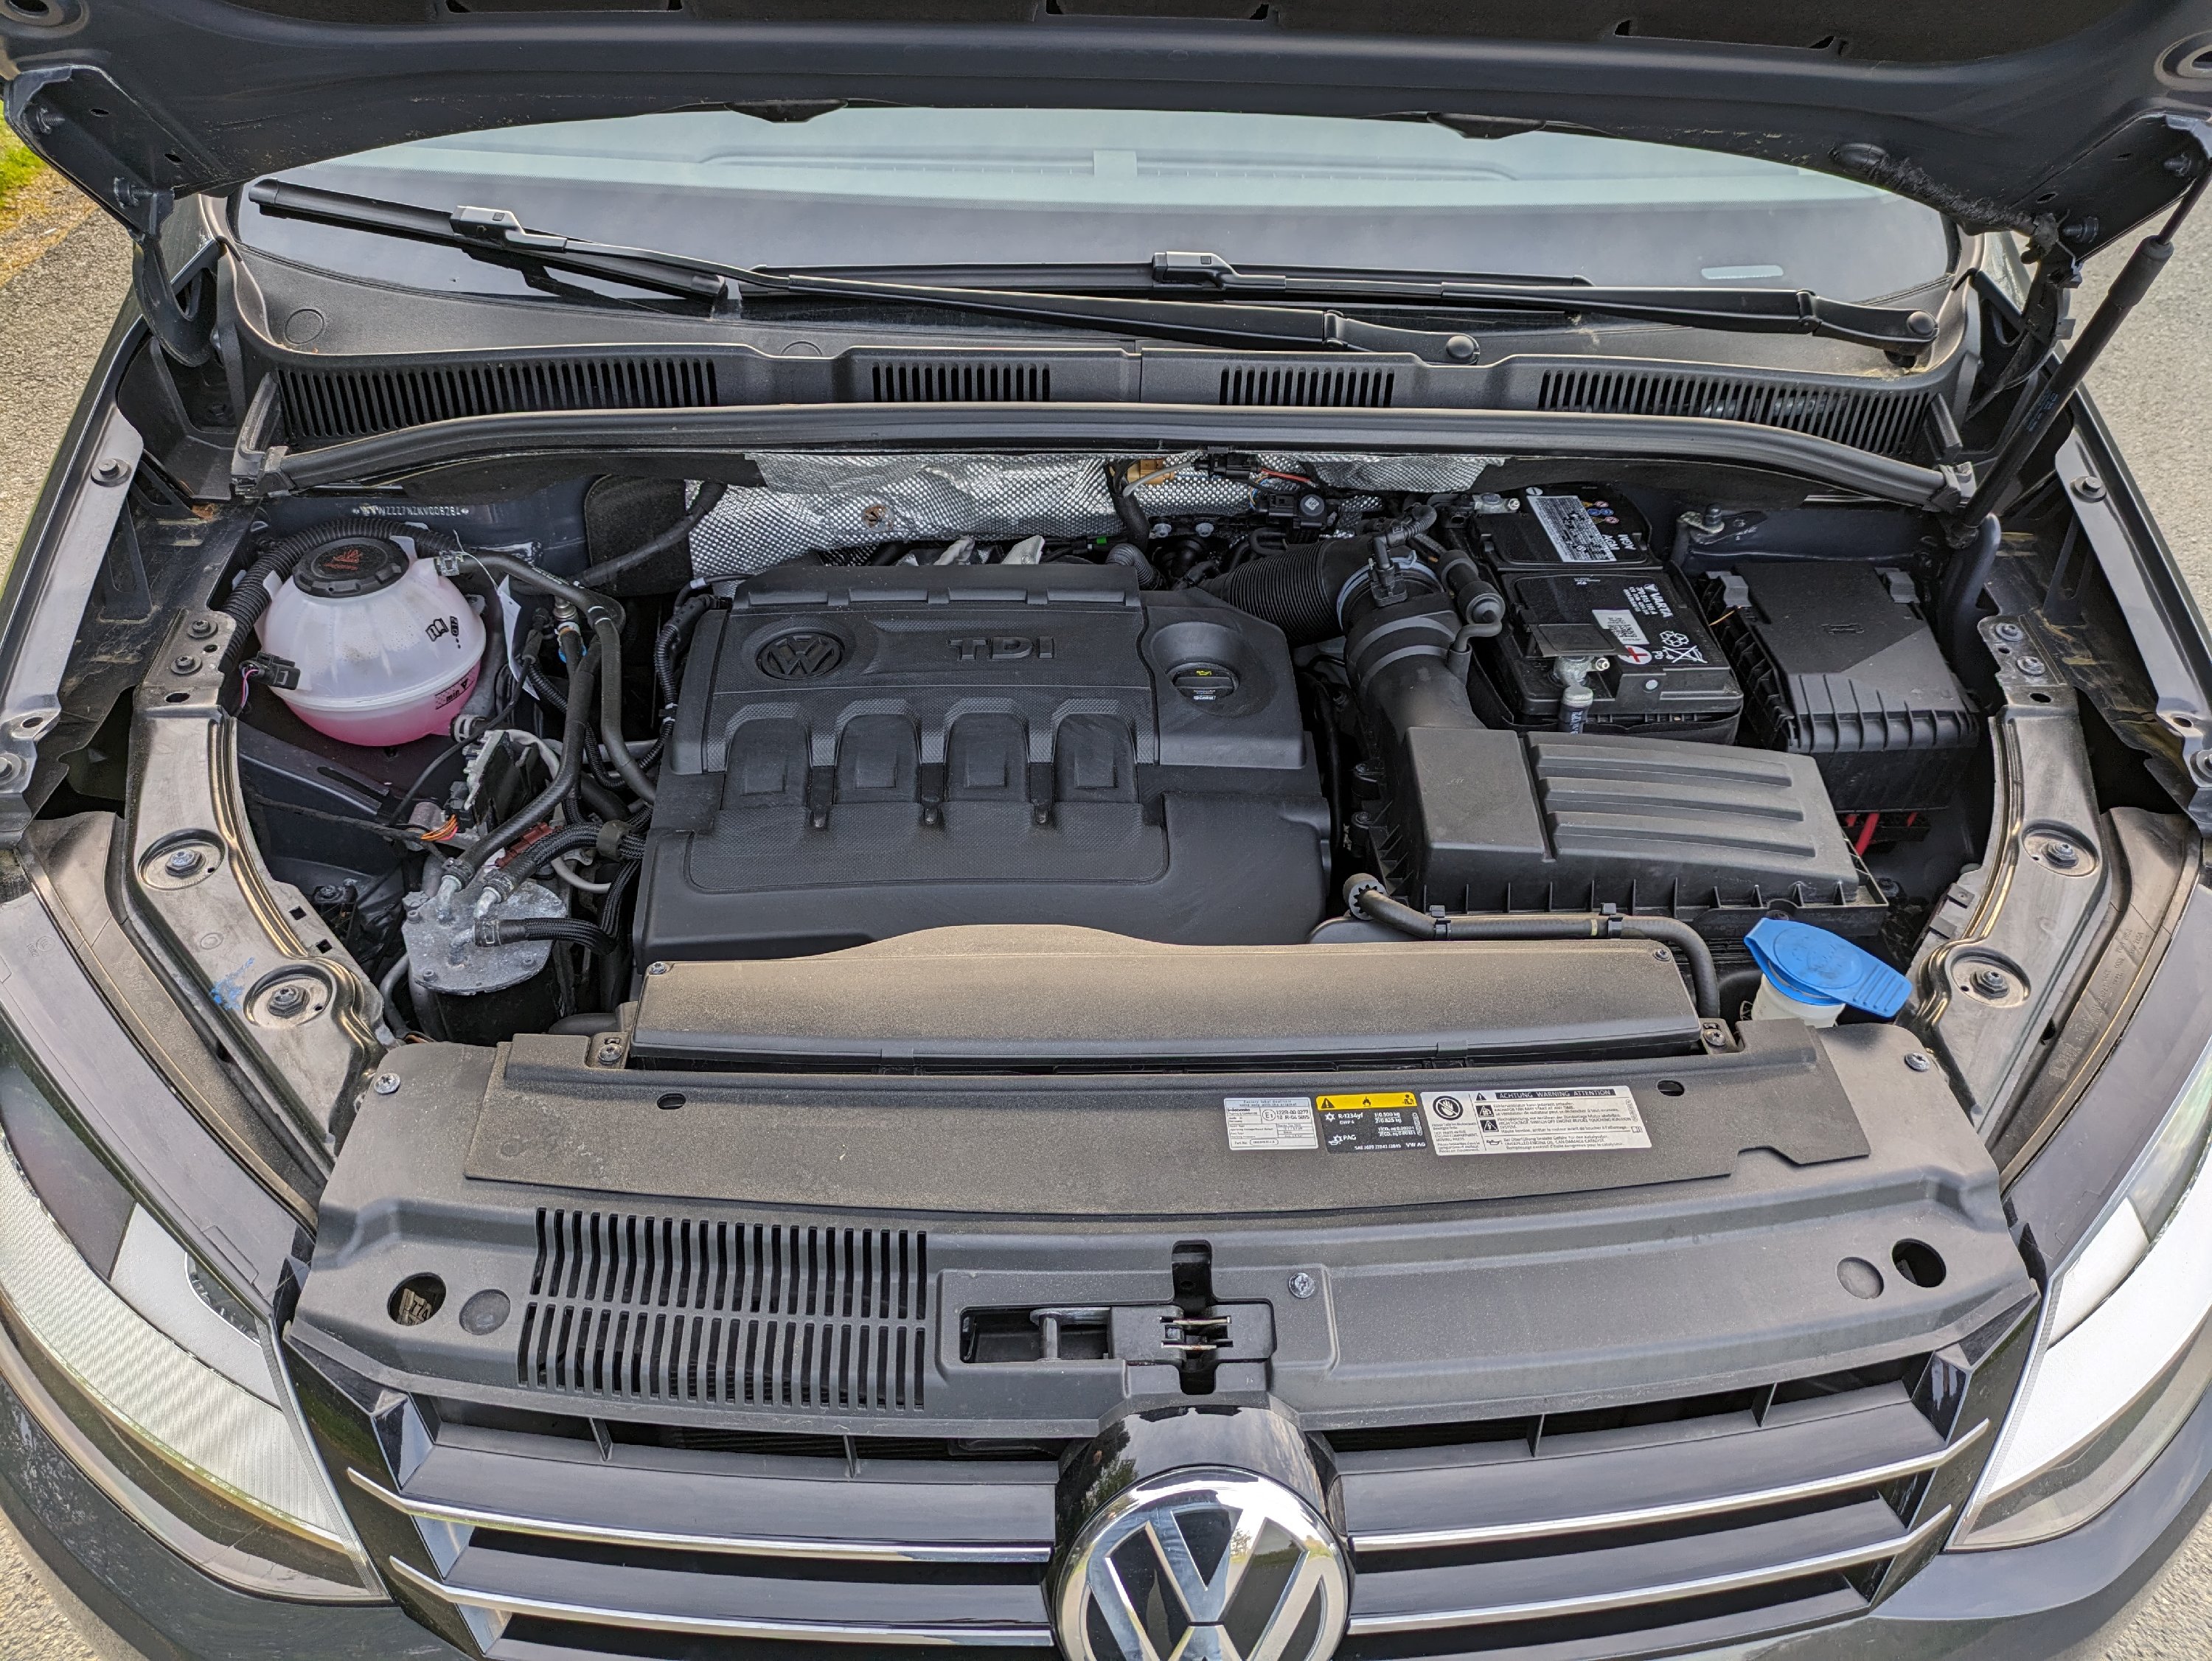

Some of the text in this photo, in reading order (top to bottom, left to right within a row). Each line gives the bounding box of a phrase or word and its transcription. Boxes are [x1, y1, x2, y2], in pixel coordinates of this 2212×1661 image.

[1650, 592, 1674, 617] VARTA
[947, 636, 1055, 661] TDI
[446, 689, 460, 702] min
[1338, 1112, 1363, 1120] R-1234yf
